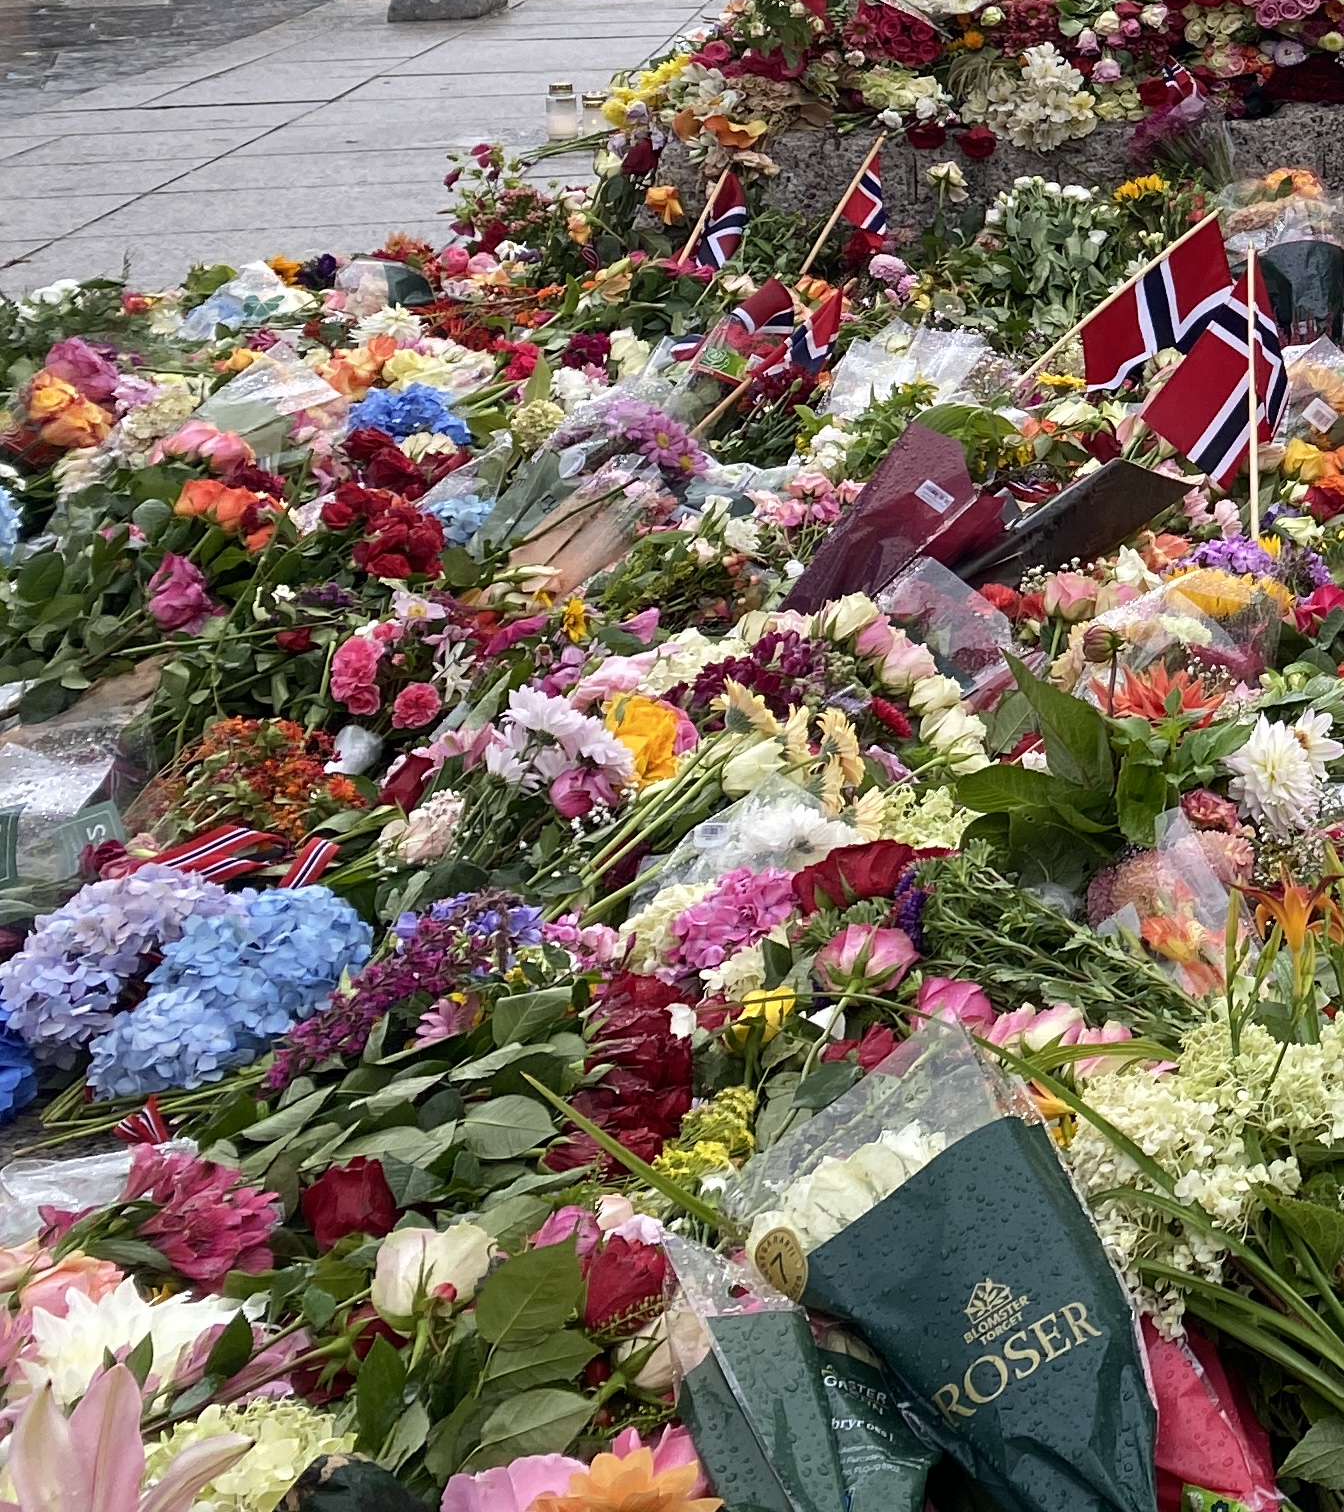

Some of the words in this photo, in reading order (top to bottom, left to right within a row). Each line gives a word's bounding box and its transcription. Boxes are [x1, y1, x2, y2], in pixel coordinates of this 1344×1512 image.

[769, 1251, 788, 1285] 7
[963, 1295, 1031, 1344] BLOMSTER
[979, 1311, 1024, 1345] TORGET
[931, 1301, 1102, 1429] ROSER
